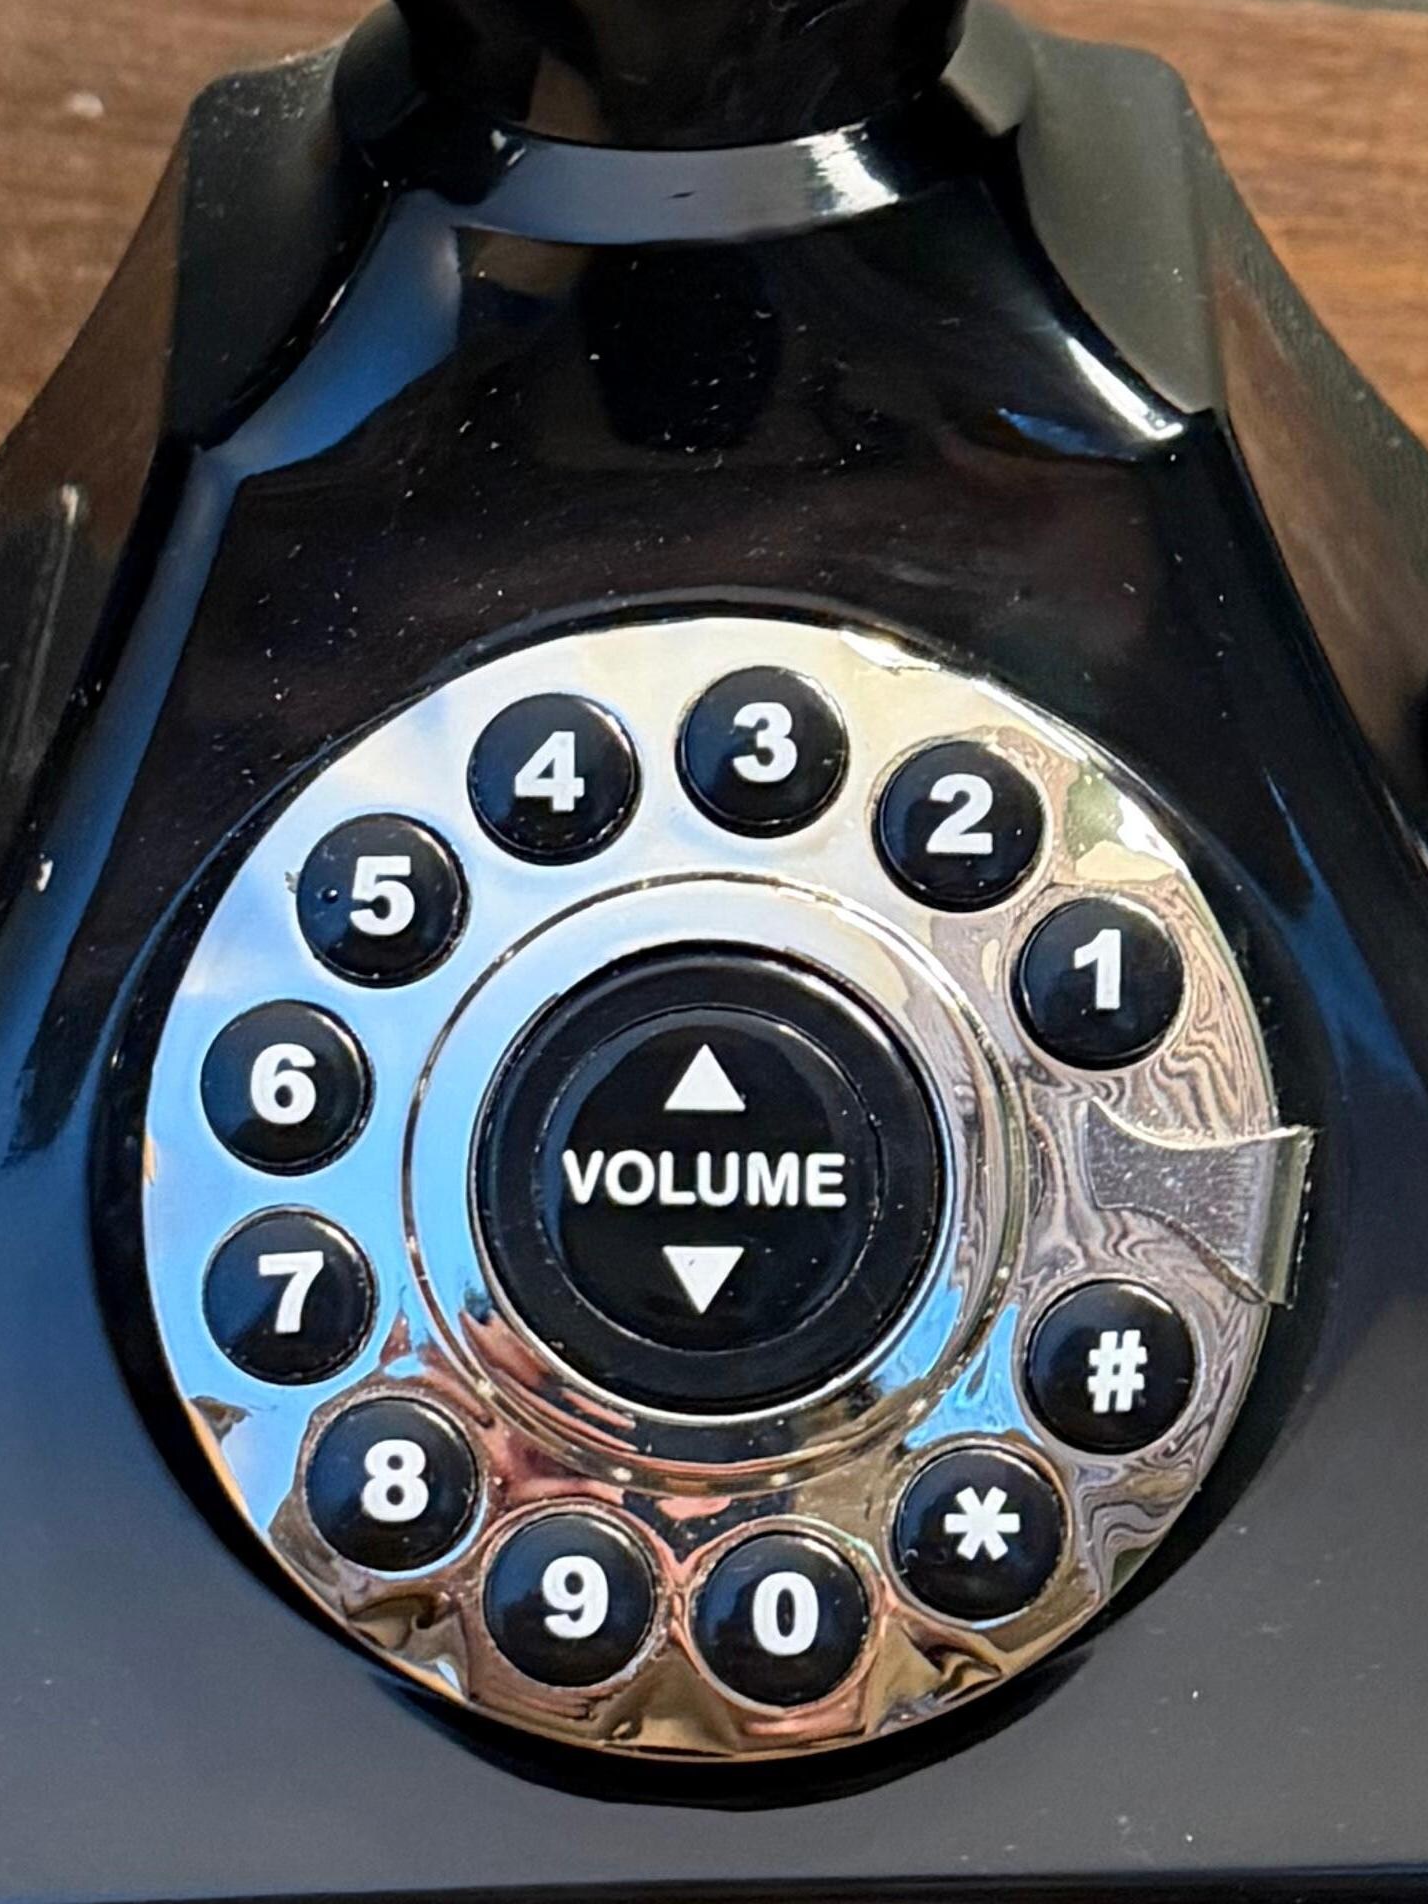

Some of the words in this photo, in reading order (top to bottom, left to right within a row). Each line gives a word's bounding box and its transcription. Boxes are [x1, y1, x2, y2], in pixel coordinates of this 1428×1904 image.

[514, 730, 585, 812] 4
[732, 701, 798, 783] 3
[925, 772, 994, 855] 2
[349, 855, 415, 936] 5
[1073, 928, 1122, 1010] 1
[249, 1042, 317, 1125] 6
[562, 1149, 847, 1207] VOLUME
[257, 1250, 324, 1334] 7
[1087, 1329, 1148, 1413] #
[360, 1439, 429, 1522] 8
[541, 1555, 609, 1639] 9
[752, 1571, 819, 1656] 0
